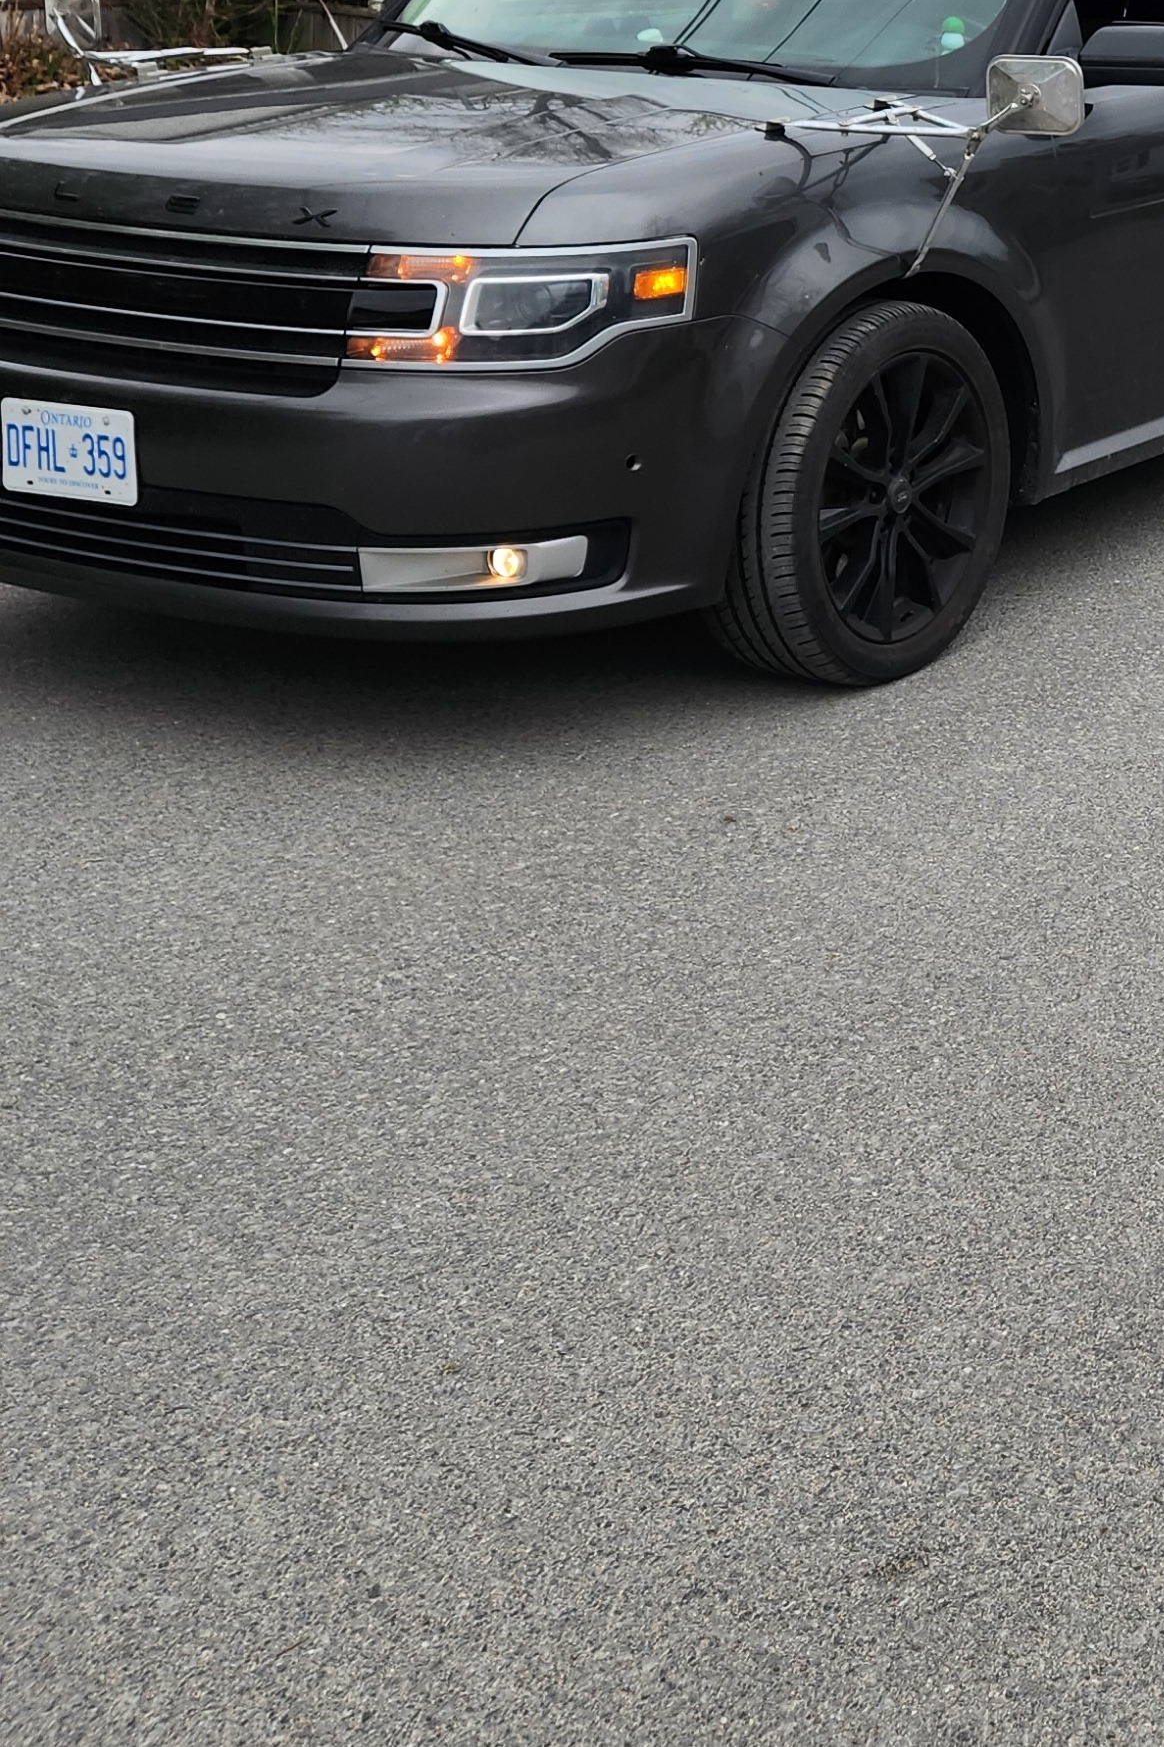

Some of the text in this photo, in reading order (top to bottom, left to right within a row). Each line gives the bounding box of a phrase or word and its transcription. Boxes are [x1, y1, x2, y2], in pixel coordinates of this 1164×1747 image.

[40, 409, 92, 429] ONTARIO
[6, 423, 126, 480] DFHL 359
